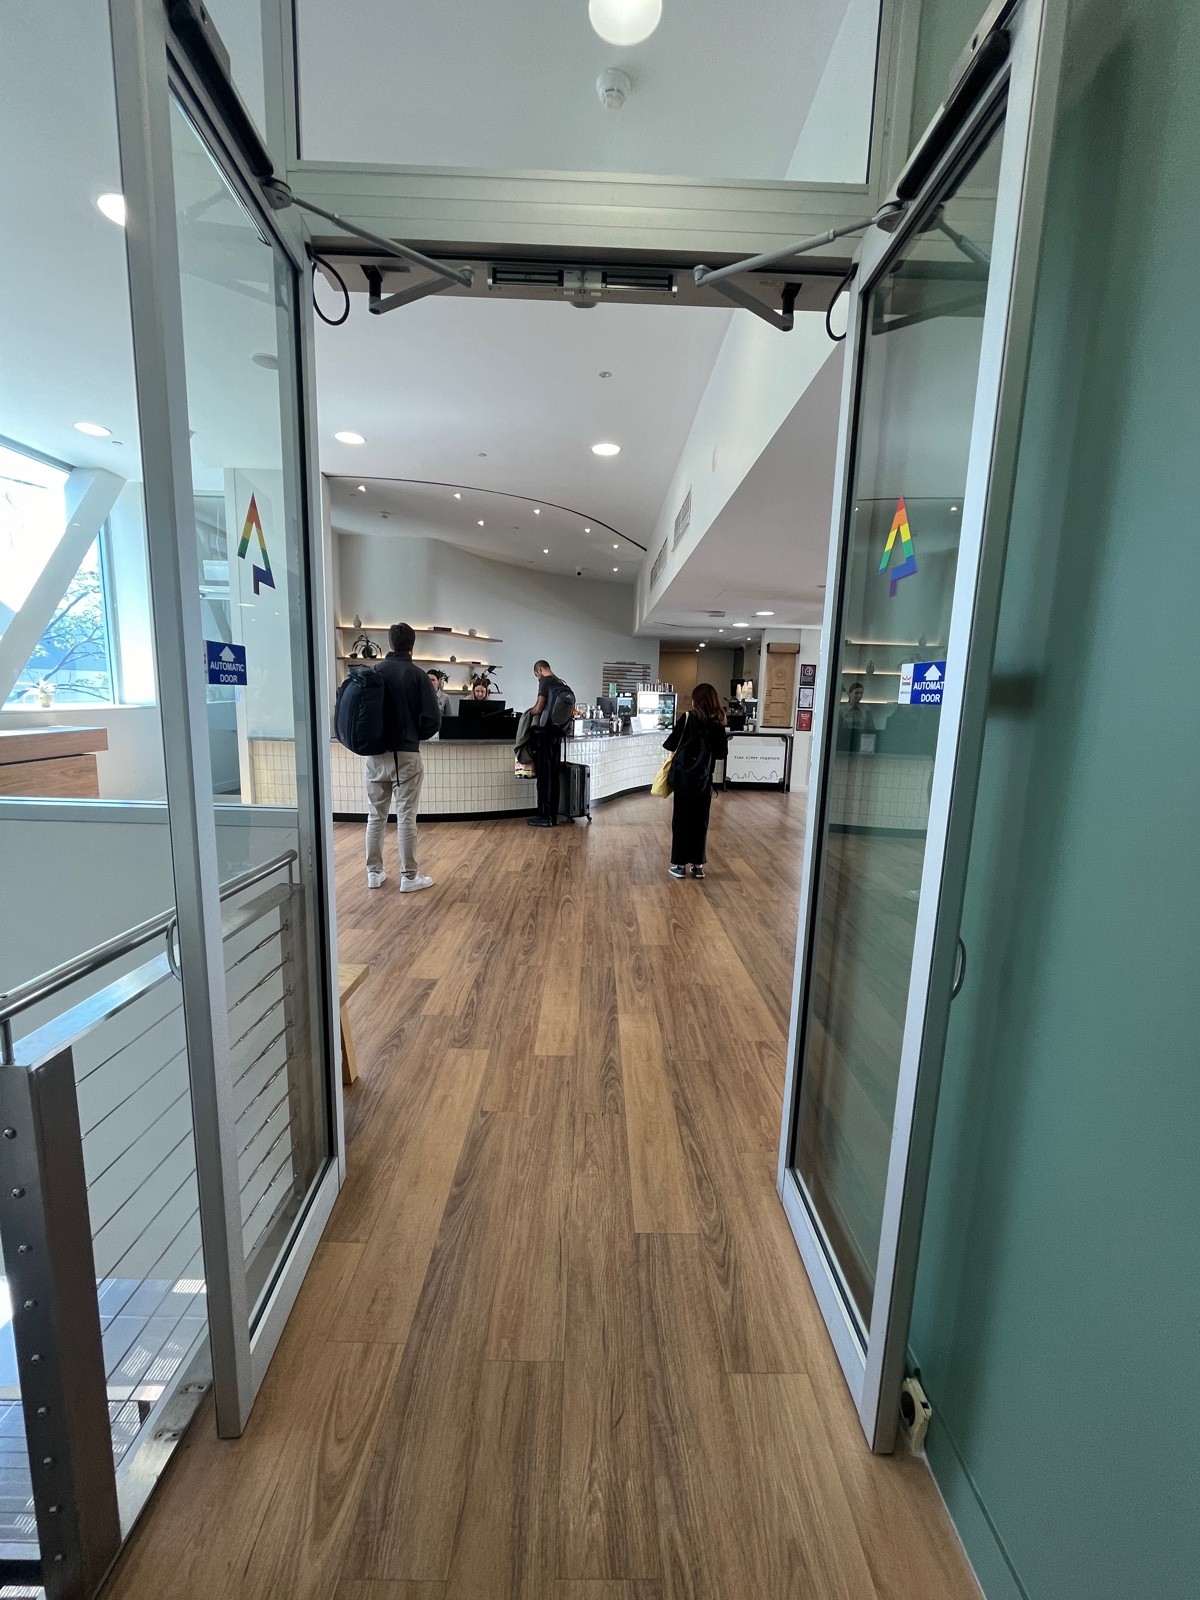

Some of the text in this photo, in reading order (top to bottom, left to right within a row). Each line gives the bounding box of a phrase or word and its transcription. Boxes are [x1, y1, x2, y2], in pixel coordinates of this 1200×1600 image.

[210, 661, 245, 672] AUTOMATIC
[220, 673, 238, 683] DOOR
[913, 681, 945, 691] AUTOMAT
[920, 693, 941, 703] DOOR
